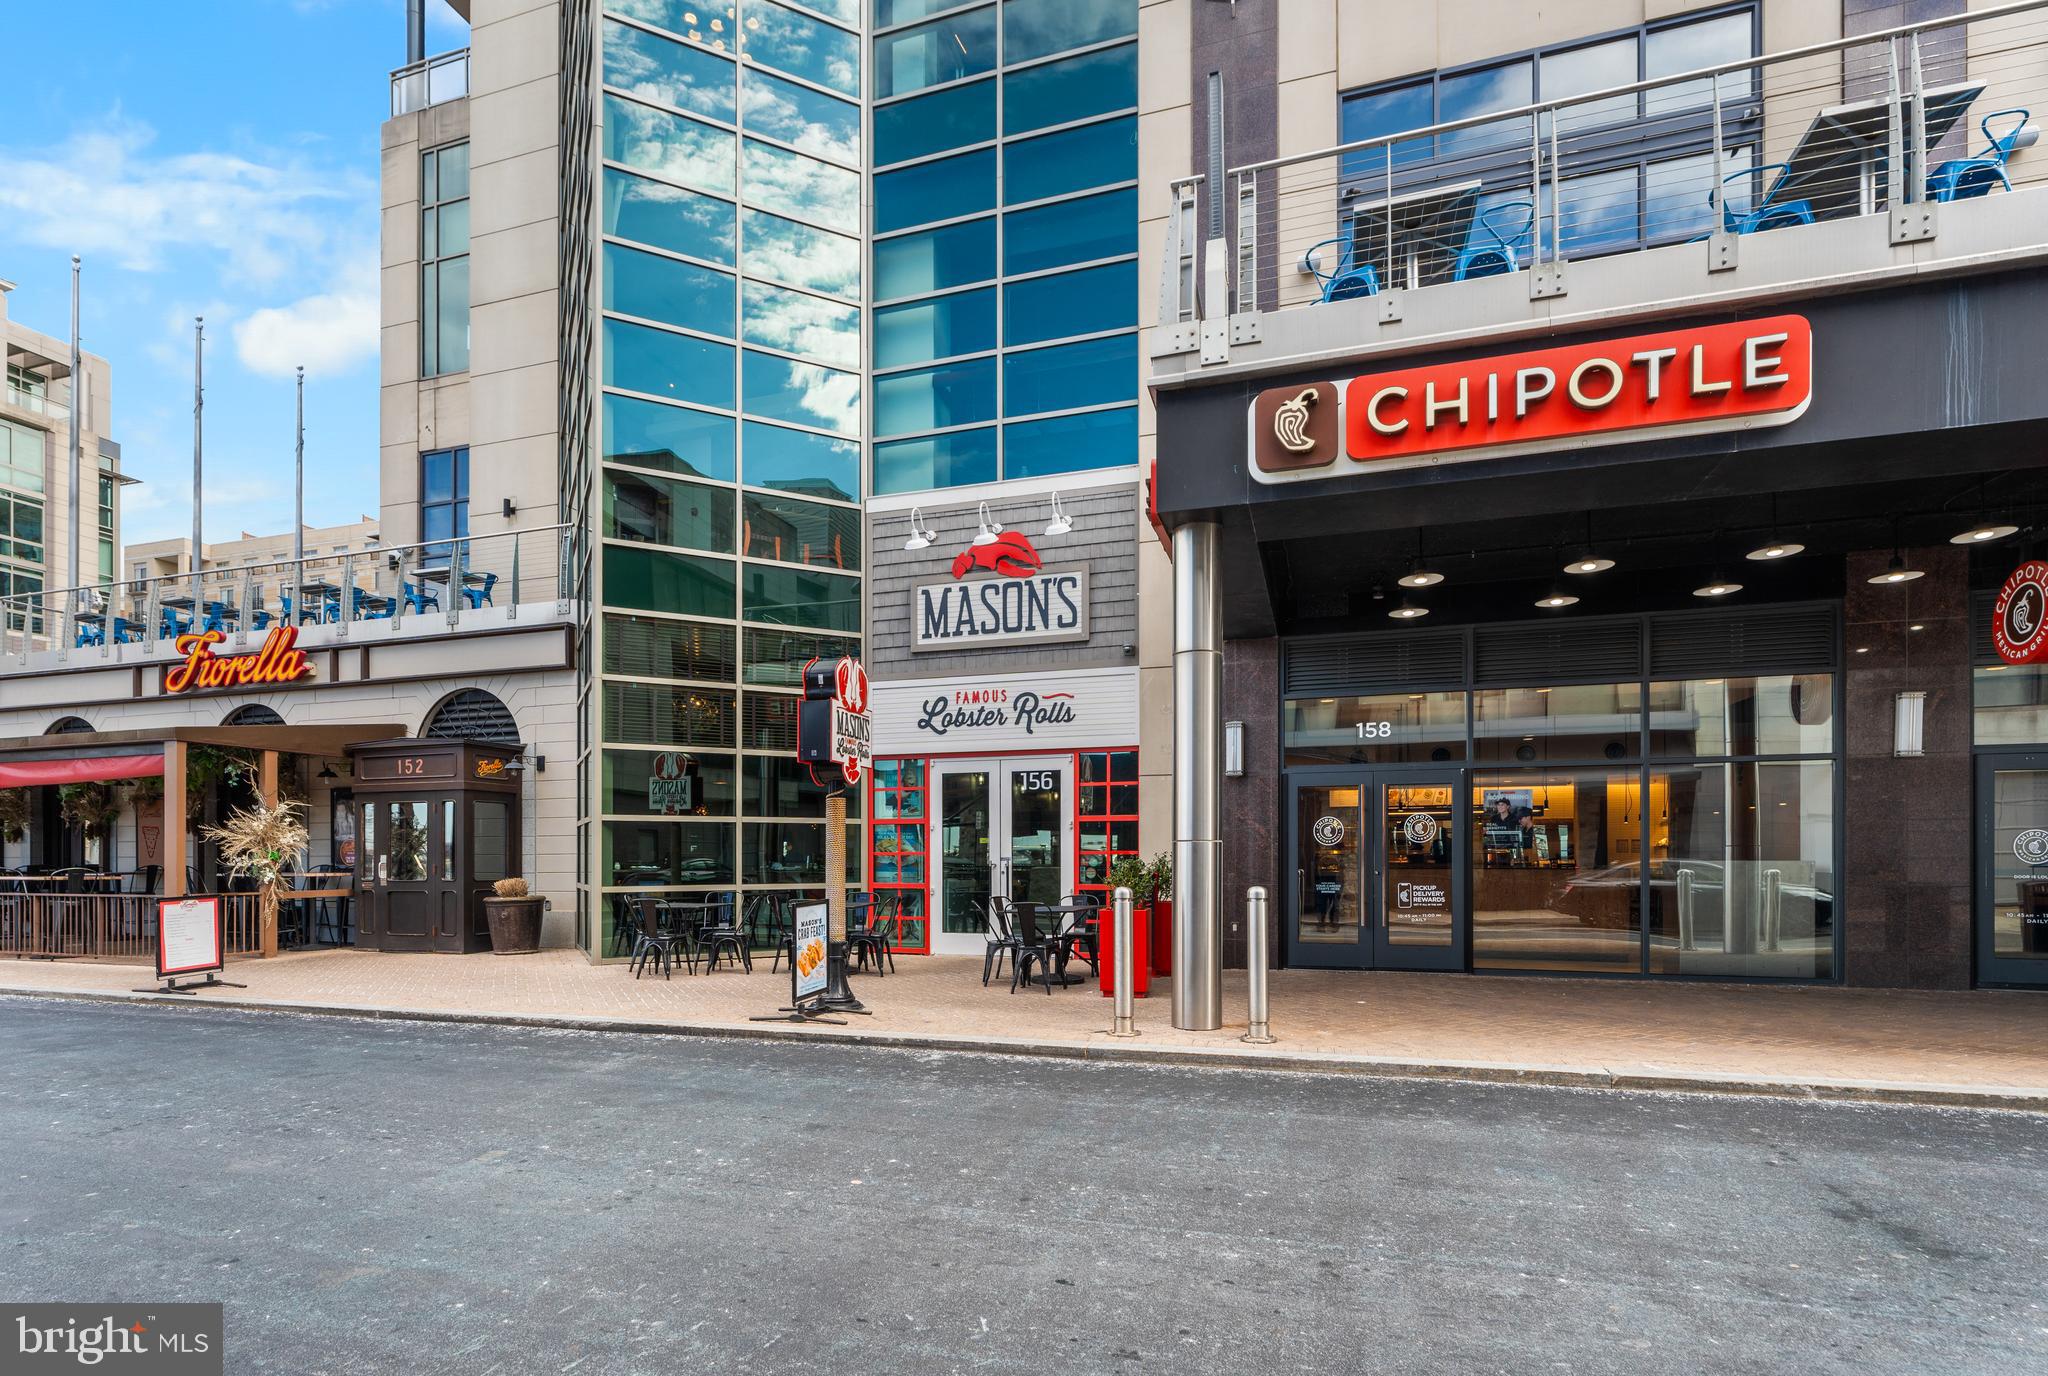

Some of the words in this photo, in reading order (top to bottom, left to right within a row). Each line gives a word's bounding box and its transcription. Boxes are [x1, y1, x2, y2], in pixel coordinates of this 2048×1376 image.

[1367, 332, 1789, 436] CHIPOTLE
[921, 577, 1078, 639] MASON'S
[1996, 631, 2029, 659] MEXICAN
[2030, 617, 2048, 651] GRIL
[165, 623, 308, 692] Fiorella
[956, 689, 1007, 705] FAMOUS
[836, 709, 870, 742] MASON'S
[918, 696, 1008, 736] Lobster
[1013, 692, 1076, 735] Rolls
[1356, 721, 1392, 738] 158
[397, 758, 424, 775] 152
[1020, 772, 1053, 790] 156
[801, 918, 822, 927] MASON'S
